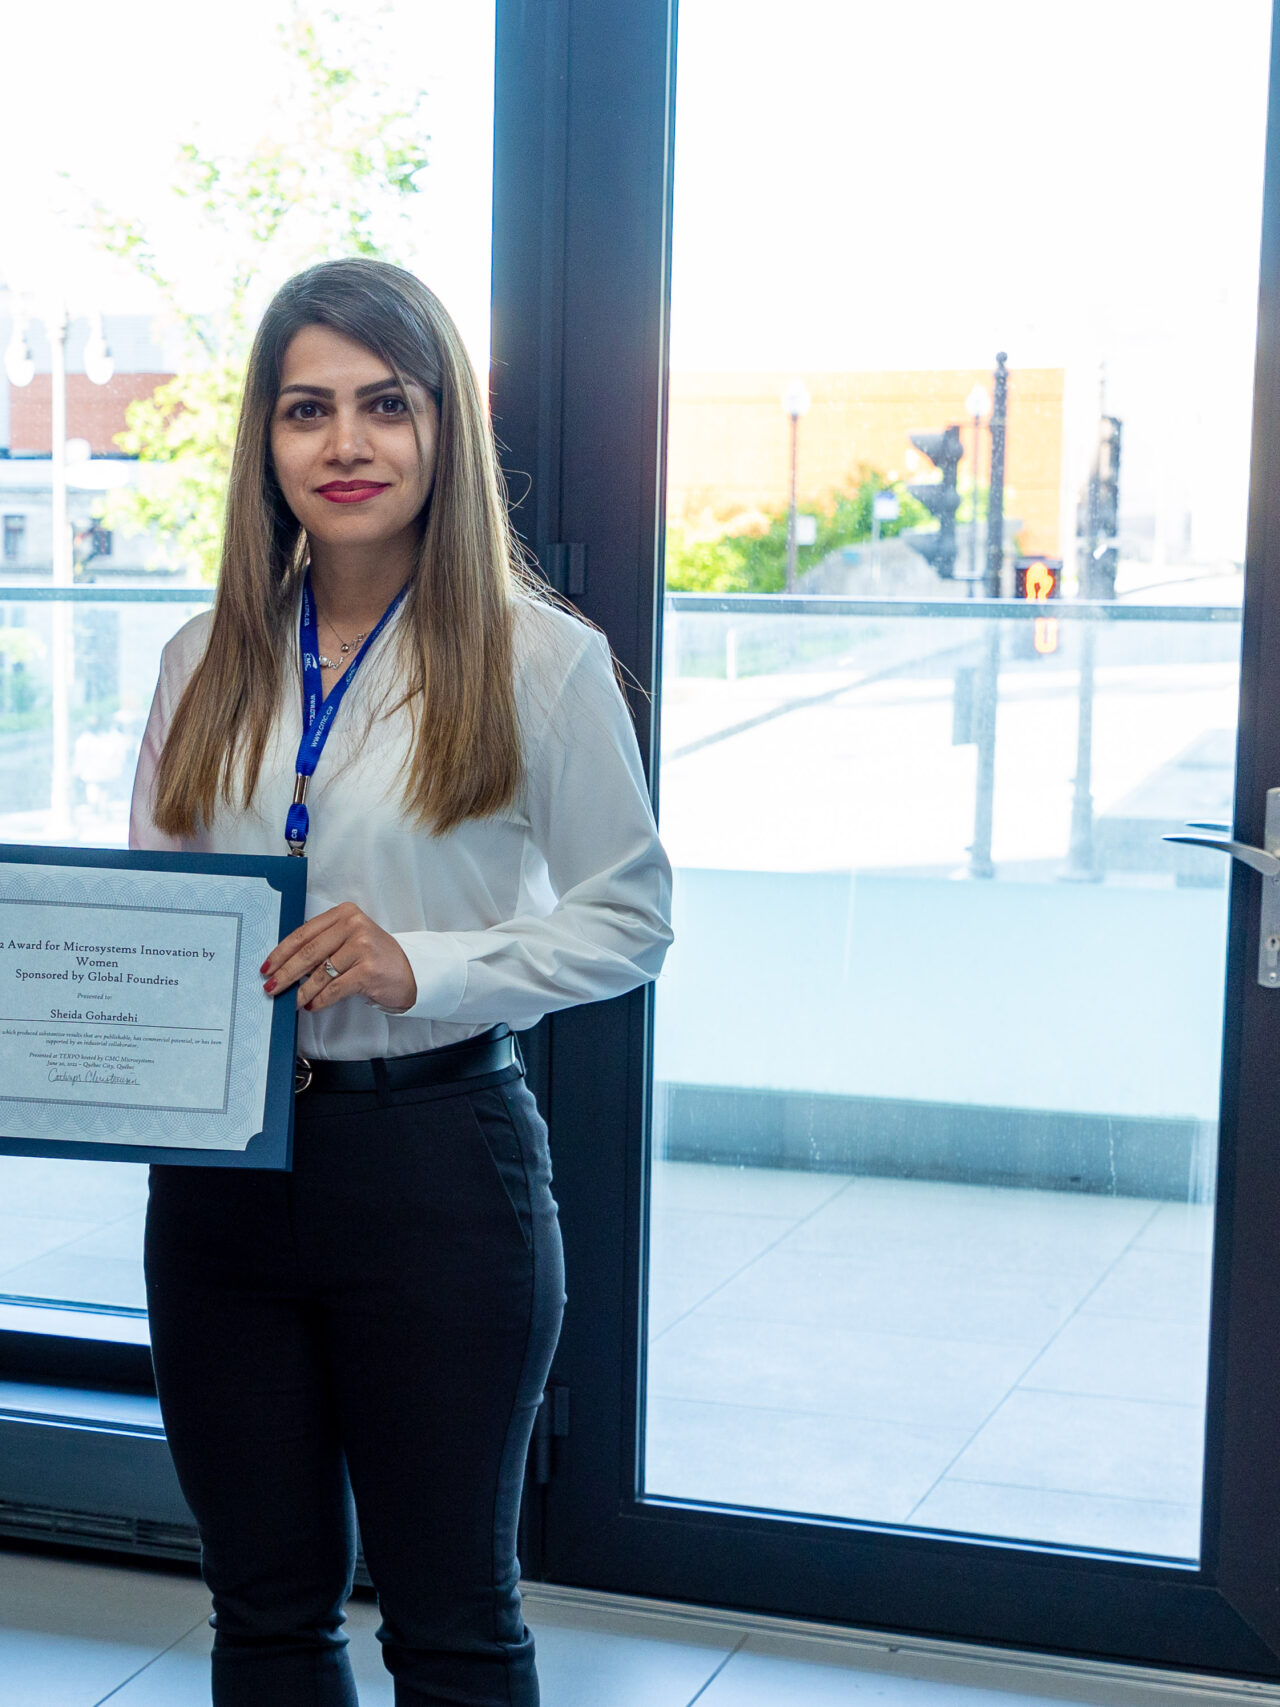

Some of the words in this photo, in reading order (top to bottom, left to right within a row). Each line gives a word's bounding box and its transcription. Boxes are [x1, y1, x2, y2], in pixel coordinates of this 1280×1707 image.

[311, 705, 334, 748] www.cmc.ca
[8, 940, 42, 951] Award
[45, 940, 61, 951] for
[63, 941, 137, 955] Microsystems
[140, 945, 199, 958] Innovation
[202, 948, 215, 961] by
[76, 956, 119, 968] Women
[15, 968, 69, 982] Sponsored
[71, 970, 84, 983] by
[87, 971, 123, 983] Global
[126, 973, 179, 986] Foundries
[50, 1009, 82, 1019] Sheida
[86, 1011, 138, 1022] Gohardehi
